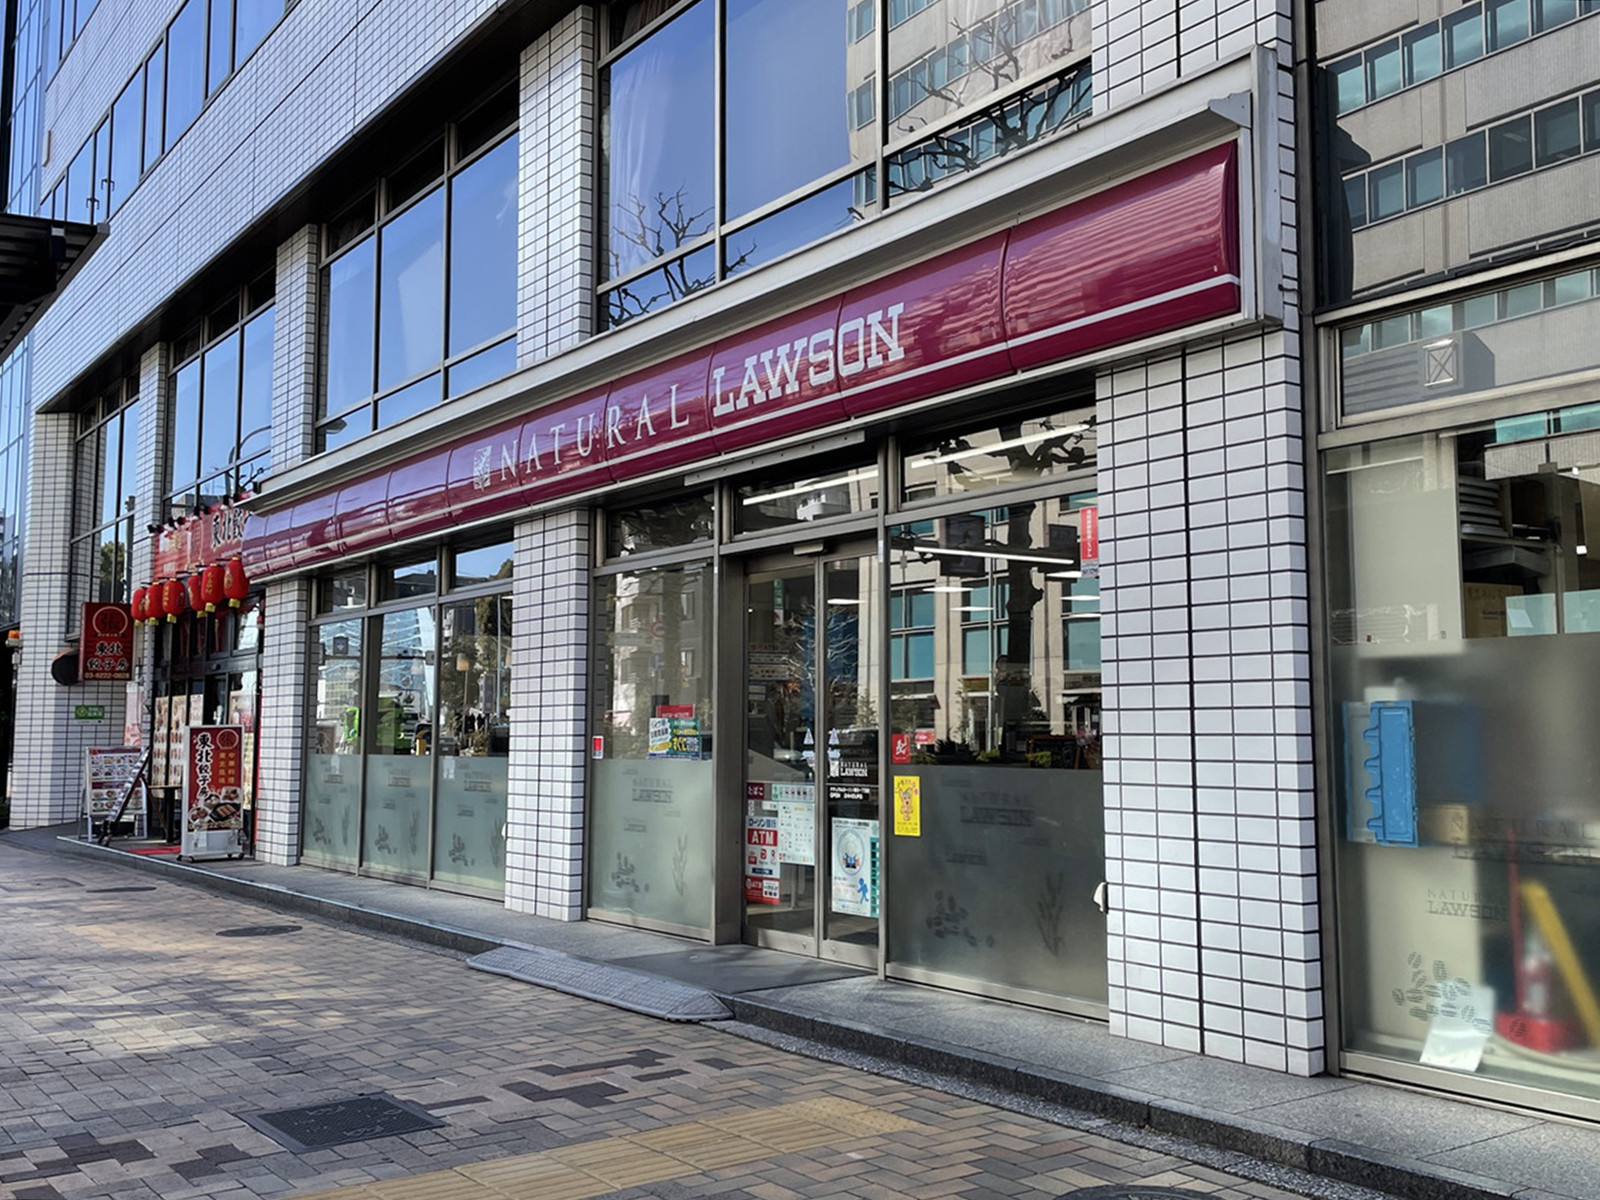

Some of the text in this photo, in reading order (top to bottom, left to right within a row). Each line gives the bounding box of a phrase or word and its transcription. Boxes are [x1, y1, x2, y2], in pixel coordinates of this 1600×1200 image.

[500, 302, 905, 482] NATURAL LAWSON
[212, 508, 254, 551] 東北餃
[96, 641, 123, 656] 東北
[87, 657, 129, 672] 餃子房
[195, 732, 215, 799] 東北餃子房
[747, 785, 764, 796] たばこ
[751, 830, 774, 845] ATM
